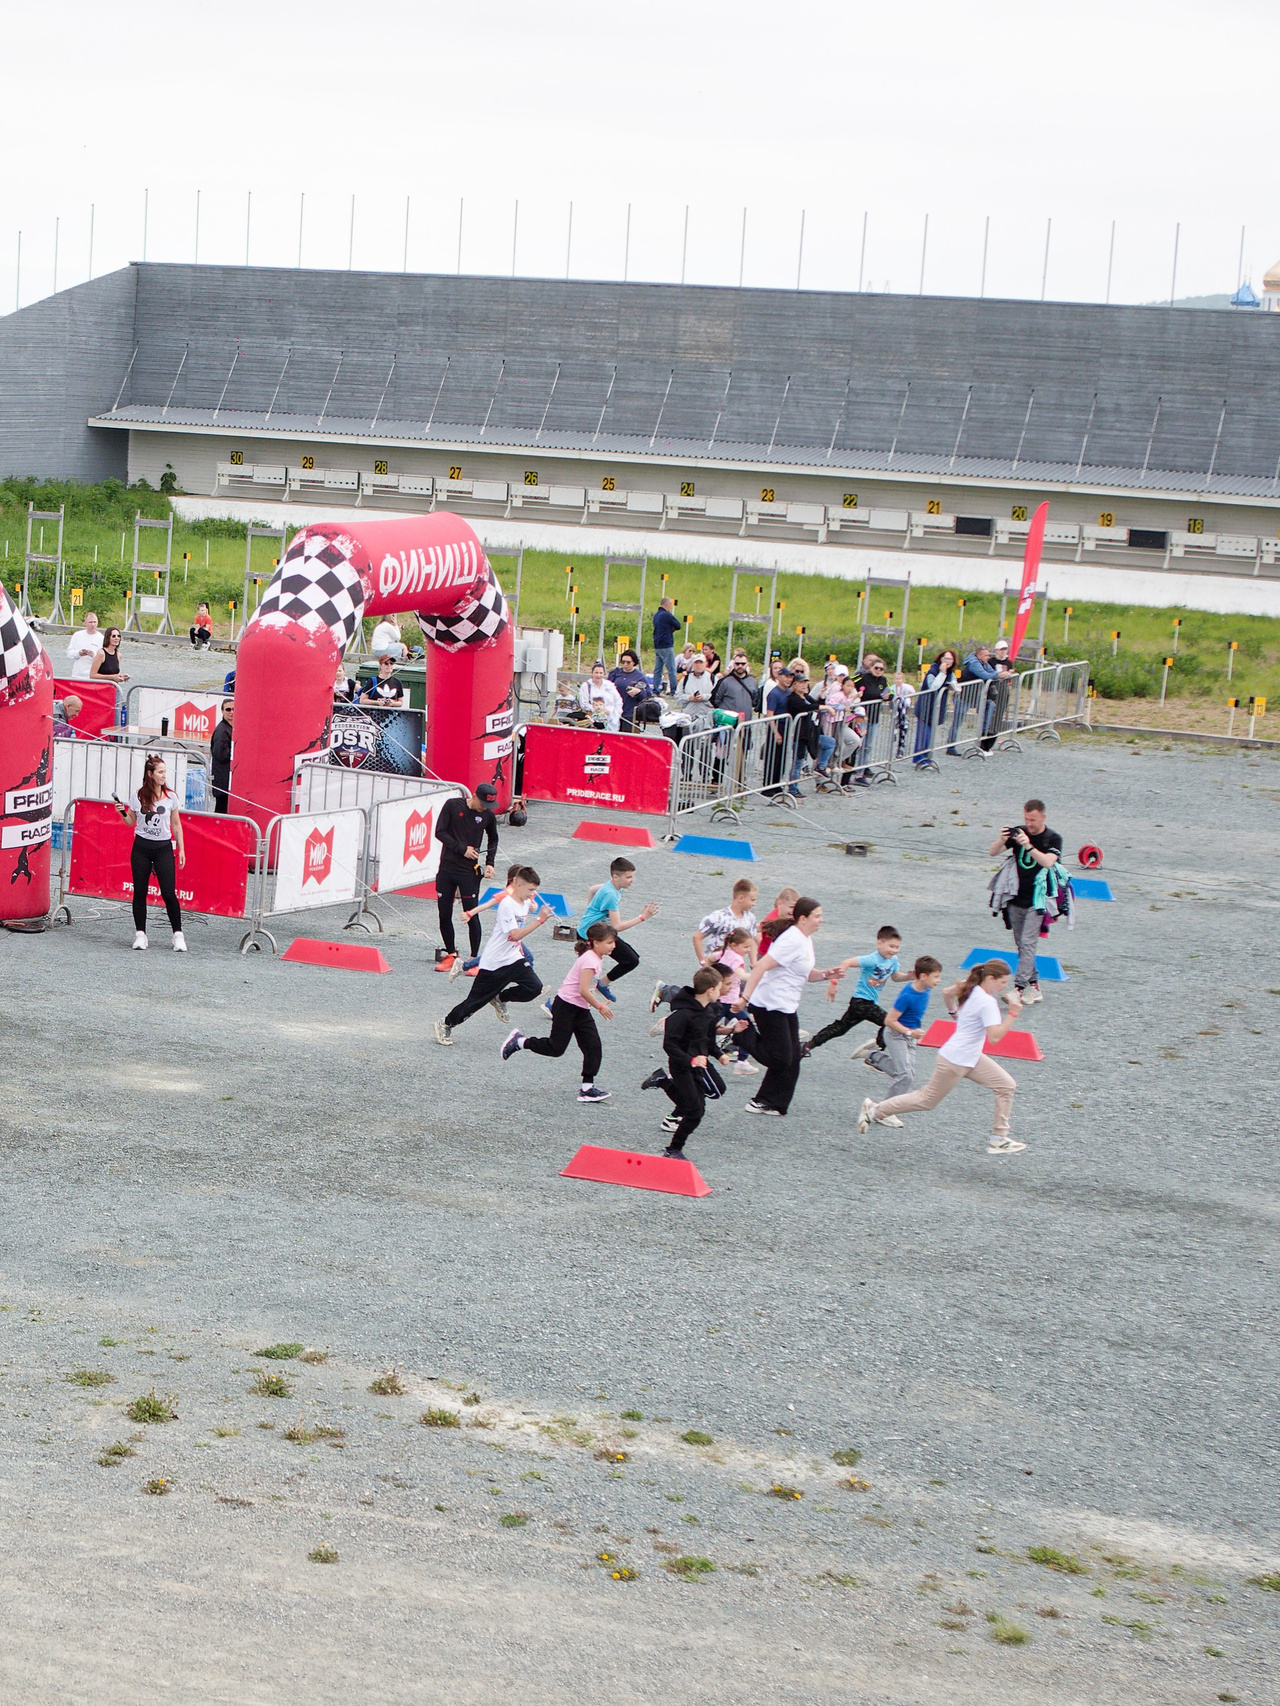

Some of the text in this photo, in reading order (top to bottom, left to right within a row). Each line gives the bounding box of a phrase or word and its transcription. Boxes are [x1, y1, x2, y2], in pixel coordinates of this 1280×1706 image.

[230, 451, 243, 464] 30
[302, 456, 314, 469] 29
[375, 461, 387, 474] 28
[449, 466, 462, 479] 27
[525, 472, 538, 485] 26
[602, 477, 615, 490] 25
[681, 483, 694, 496] 24
[761, 488, 775, 502] 23
[844, 494, 858, 508] 22
[928, 500, 940, 514] 21
[1012, 507, 1027, 520] 20
[1100, 513, 1113, 527] 19
[1189, 519, 1203, 533] 18
[379, 540, 478, 598] ФИНИШ
[73, 594, 82, 605] 21
[183, 712, 209, 732] МИР
[330, 729, 375, 755] OSR
[566, 787, 626, 803] PRIDERACE.RU
[21, 823, 51, 841] RACE
[409, 822, 428, 847] МИР
[309, 841, 328, 867] МИР
